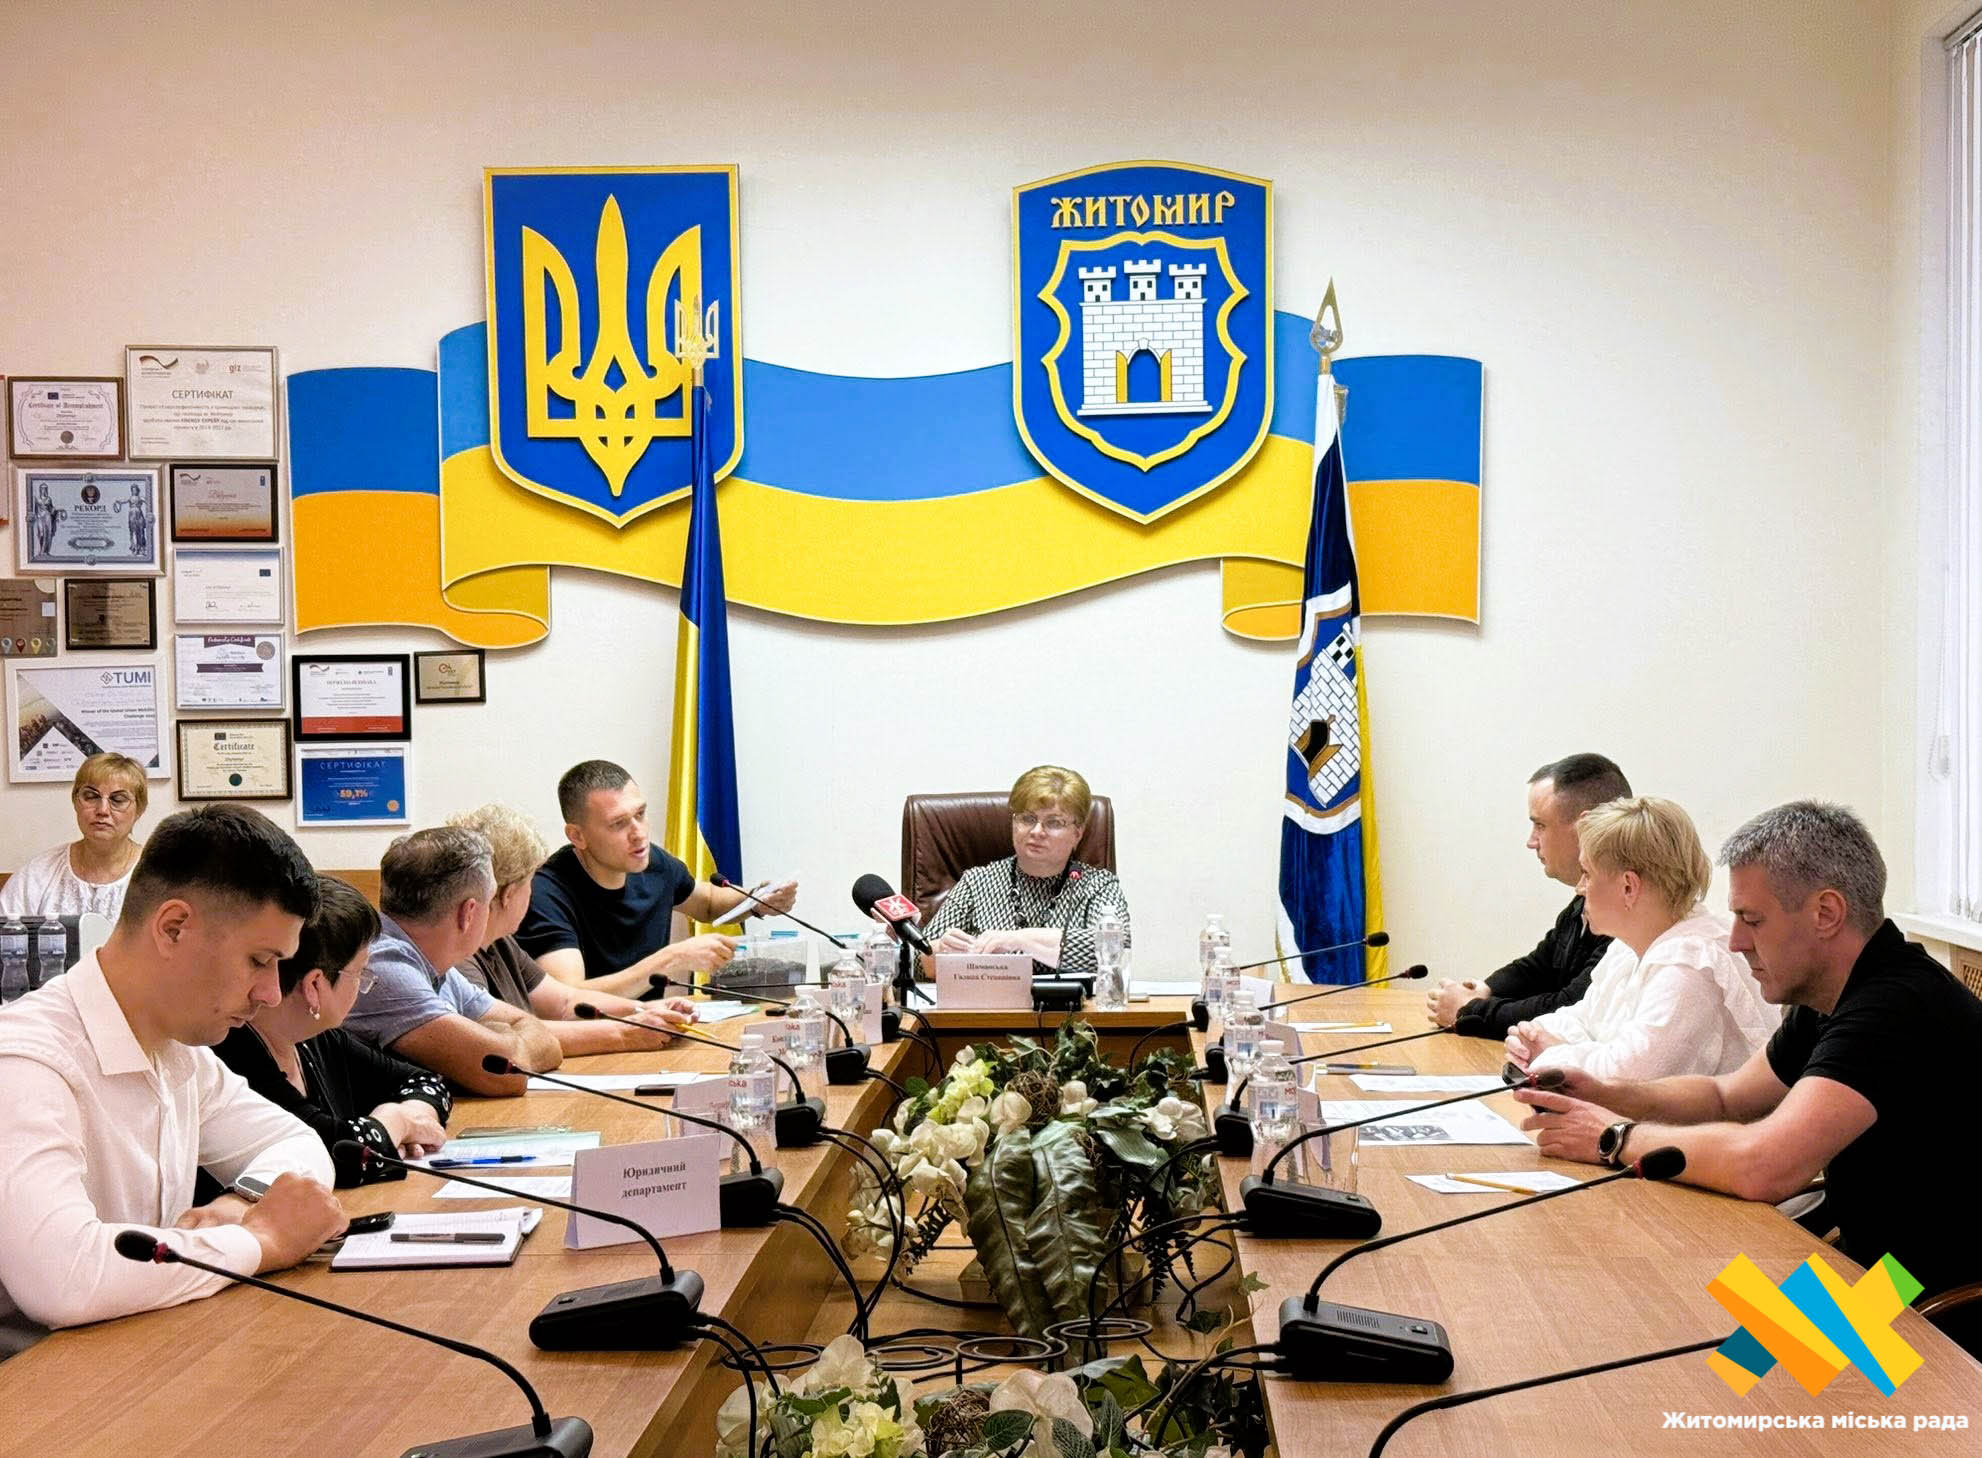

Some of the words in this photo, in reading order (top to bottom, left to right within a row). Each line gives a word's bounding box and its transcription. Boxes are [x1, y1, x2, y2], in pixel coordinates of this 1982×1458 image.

[1051, 190, 1236, 229] ЖИТОМИР
[171, 389, 234, 400] СЕРТИФІКАТ
[113, 671, 151, 684] TUMI
[214, 742, 255, 751] Certificate
[320, 761, 385, 769] СЕРТИФІКАТ
[623, 1161, 686, 1179] Юридичний
[621, 1182, 687, 1199] департамент
